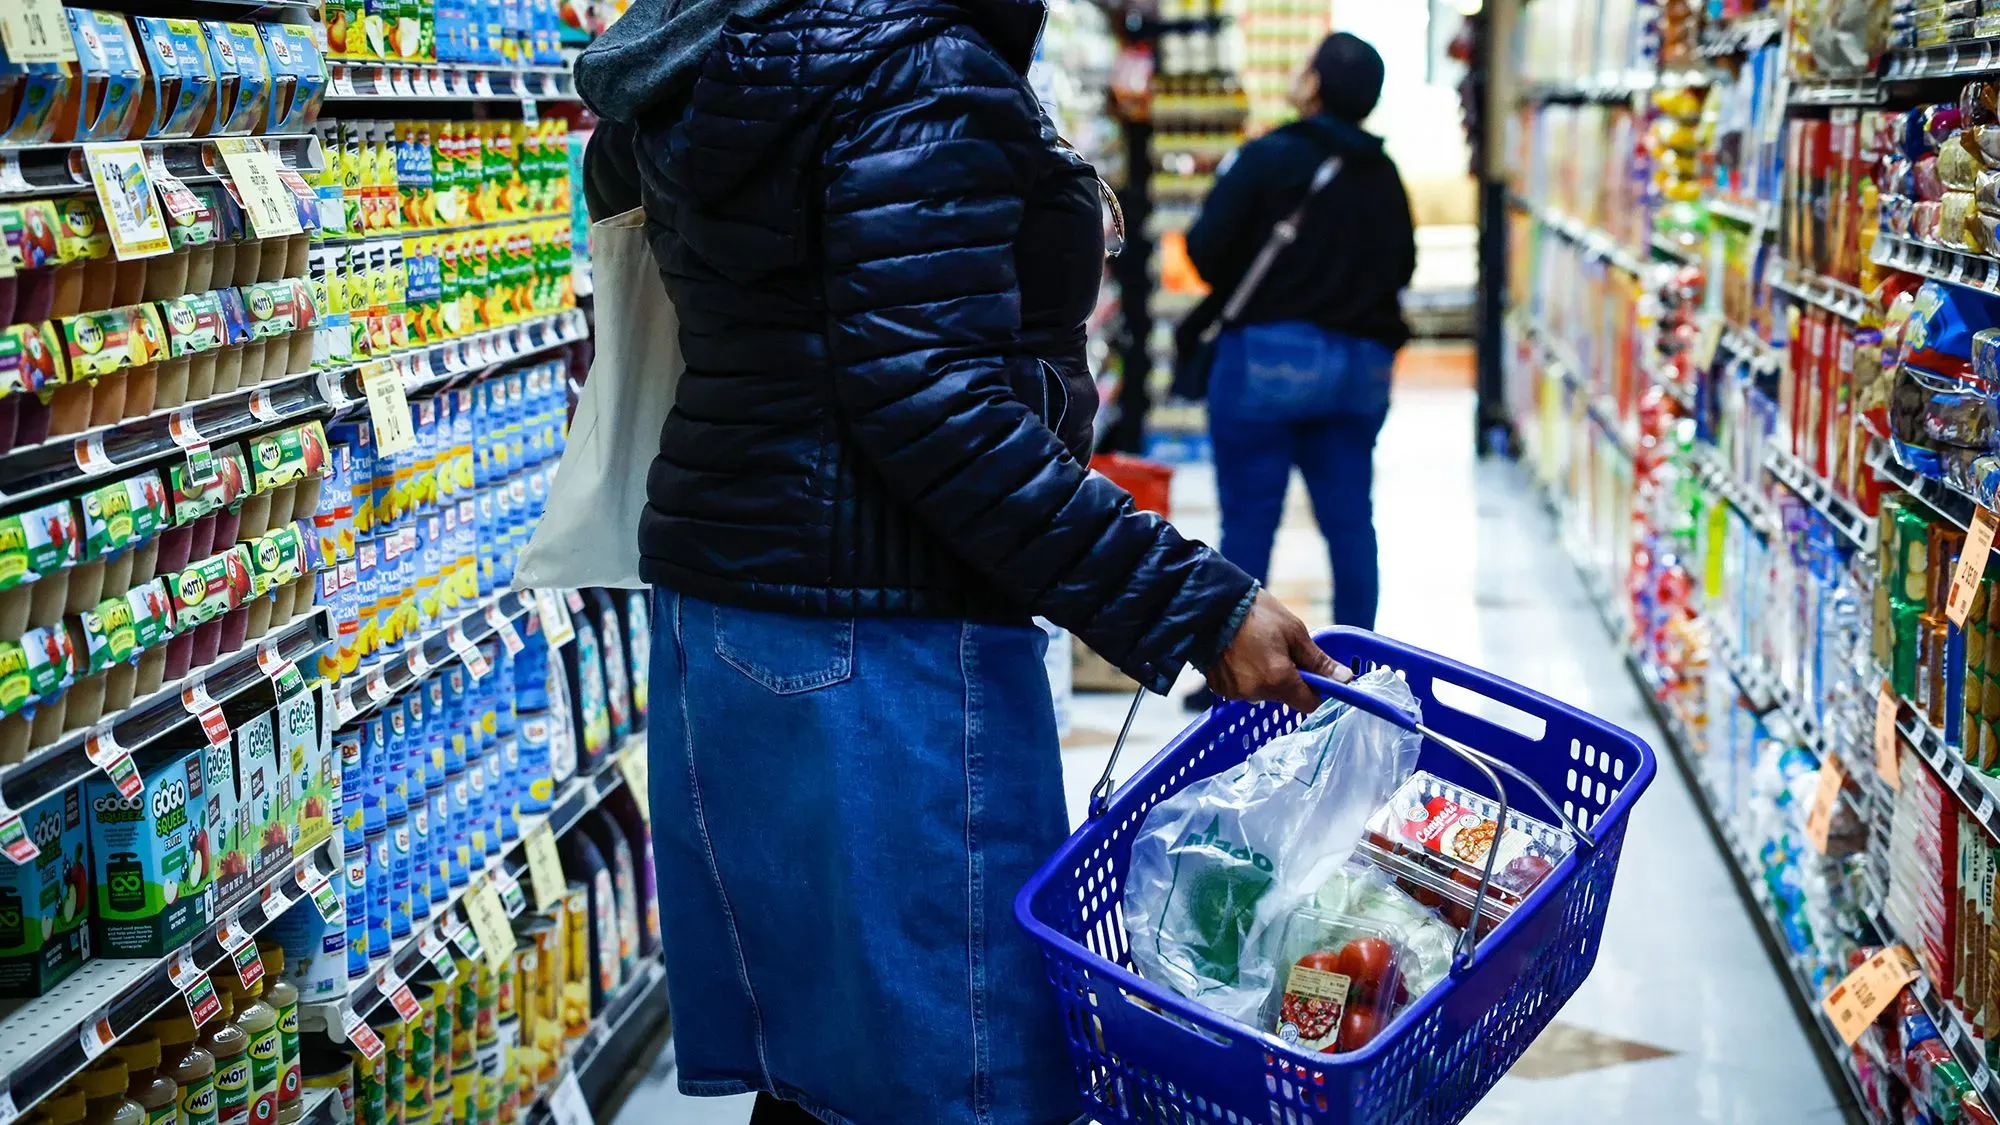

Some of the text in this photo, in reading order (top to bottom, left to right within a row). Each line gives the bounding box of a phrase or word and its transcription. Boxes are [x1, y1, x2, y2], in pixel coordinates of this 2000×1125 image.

[182, 577, 205, 598] MOTT'S
[289, 700, 310, 735] GoGo
[249, 722, 268, 758] GoGo
[206, 748, 226, 785] GoGo
[93, 796, 144, 813] GOGO
[152, 780, 186, 819] GOGO
[156, 806, 188, 838] SQUEEZ
[1414, 801, 1458, 843] Campari
[1985, 856, 1996, 908] Maria
